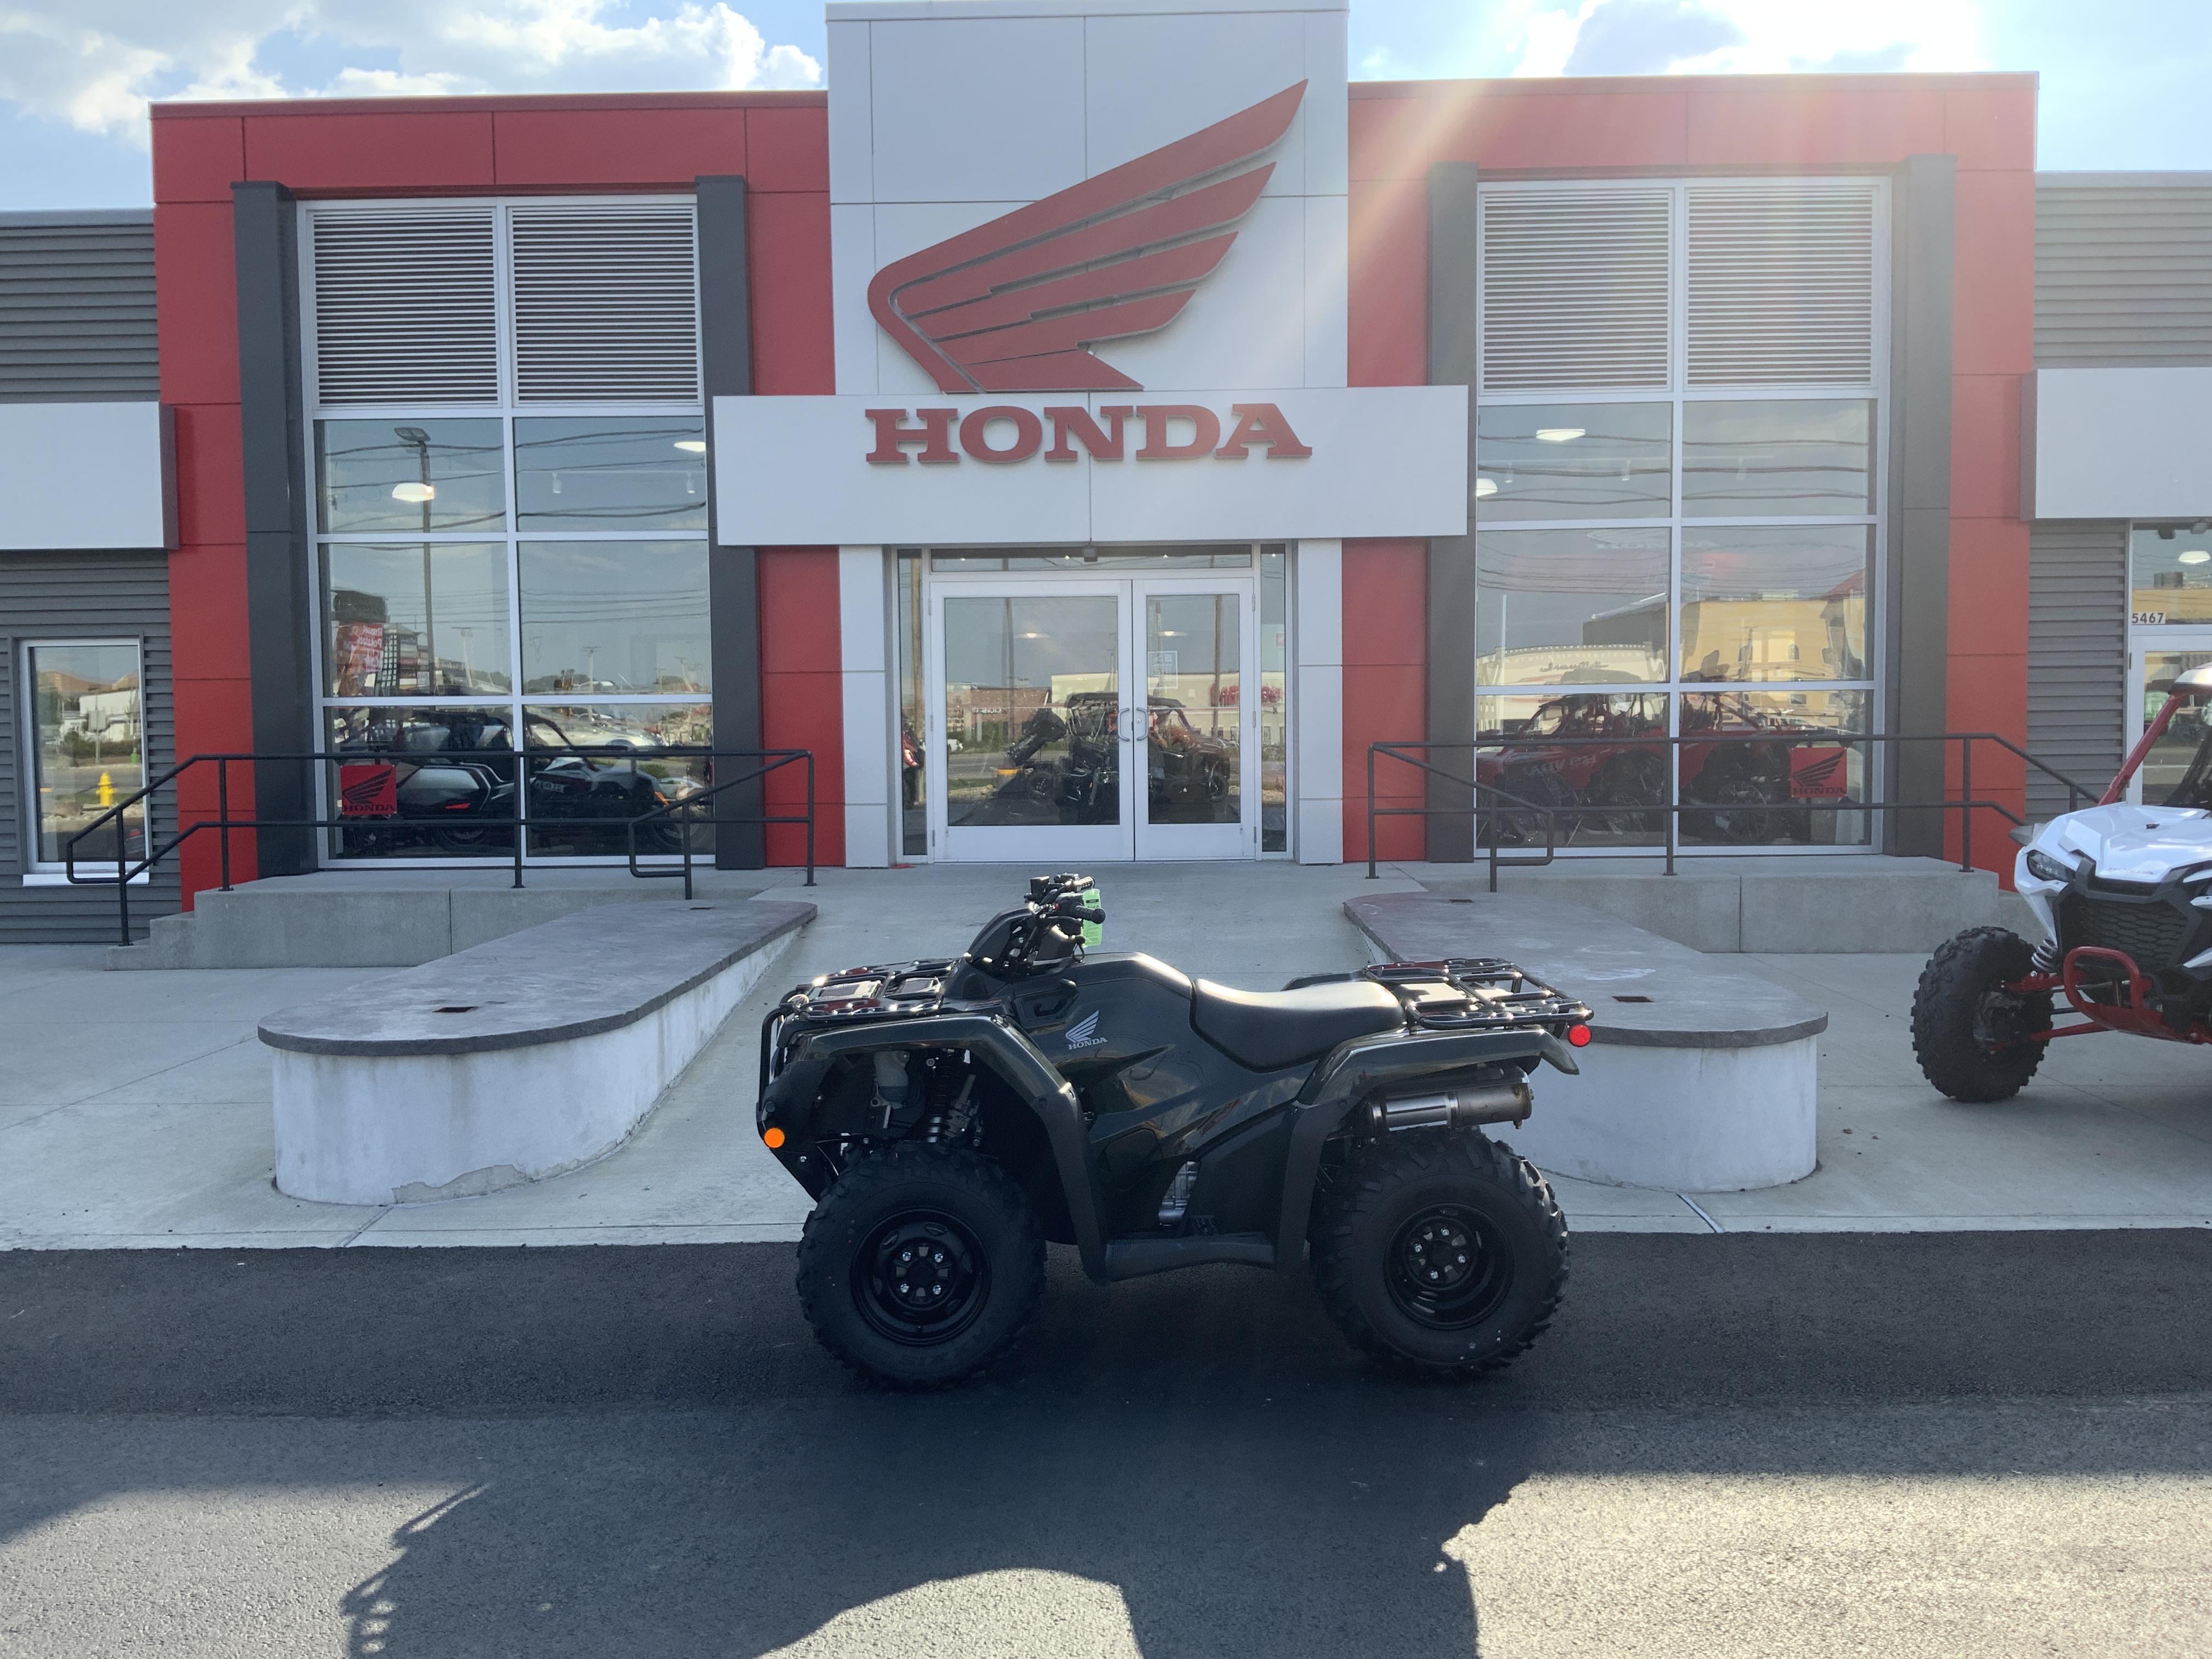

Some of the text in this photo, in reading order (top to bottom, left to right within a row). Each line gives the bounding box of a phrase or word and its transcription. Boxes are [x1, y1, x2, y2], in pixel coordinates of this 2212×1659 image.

[865, 403, 1313, 464] HONDA
[2132, 612, 2164, 624] 5467
[2108, 867, 2154, 875] HONDA
[1068, 1037, 1108, 1050] HONDA
